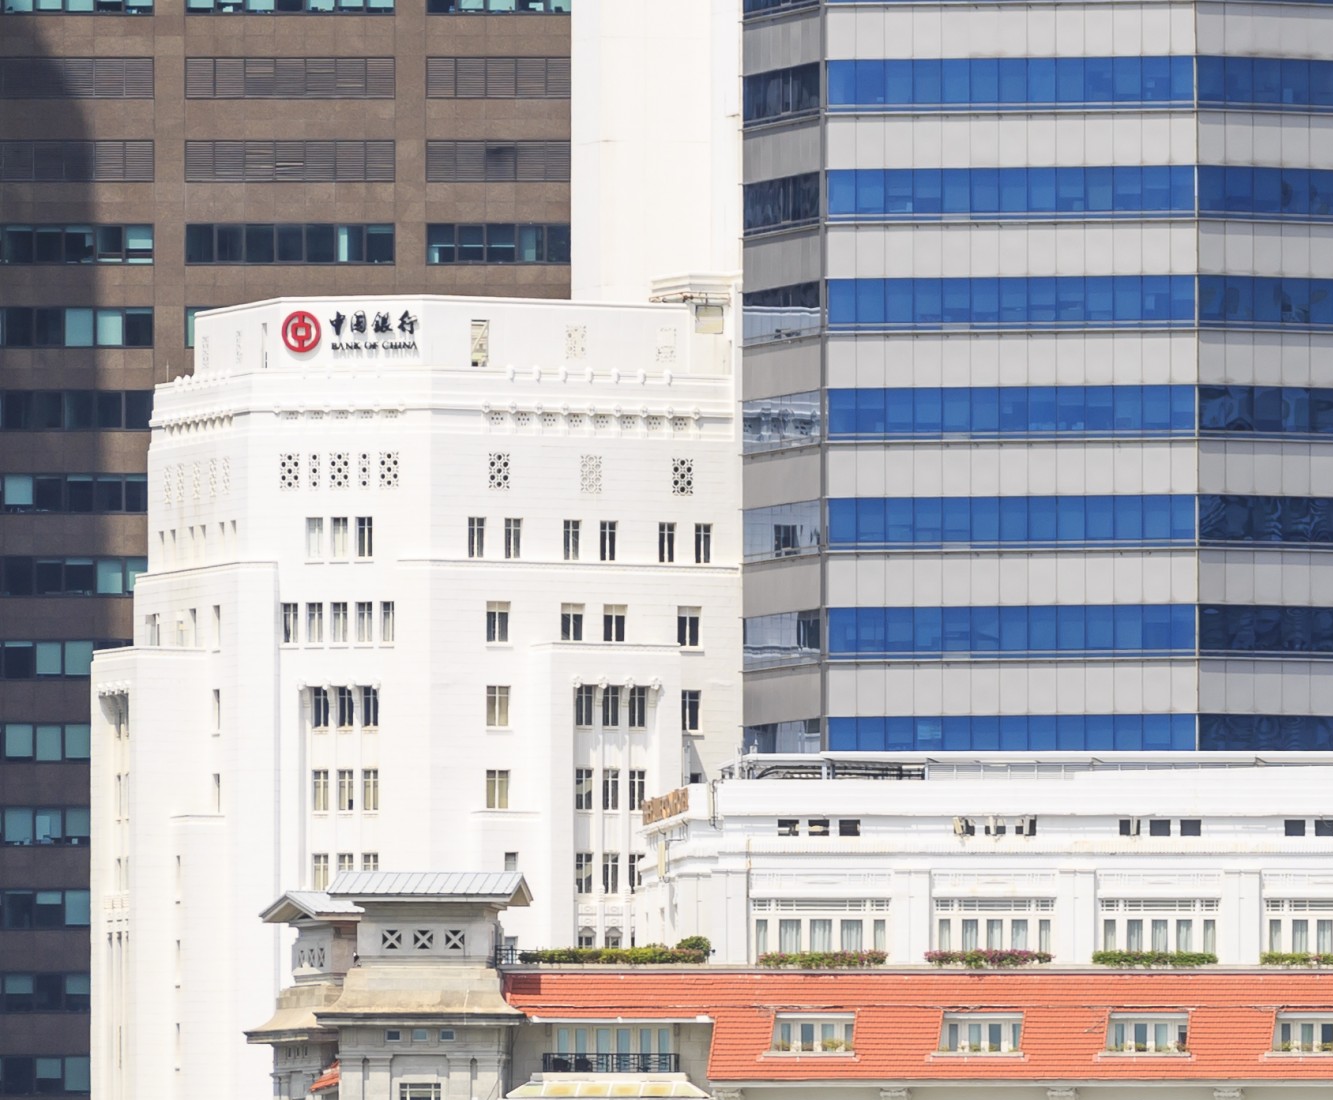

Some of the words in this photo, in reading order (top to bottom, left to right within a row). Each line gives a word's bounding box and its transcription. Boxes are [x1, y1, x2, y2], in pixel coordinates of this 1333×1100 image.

[331, 341, 361, 350] BANK
[364, 341, 379, 350] OF
[382, 341, 418, 350] CHINA
